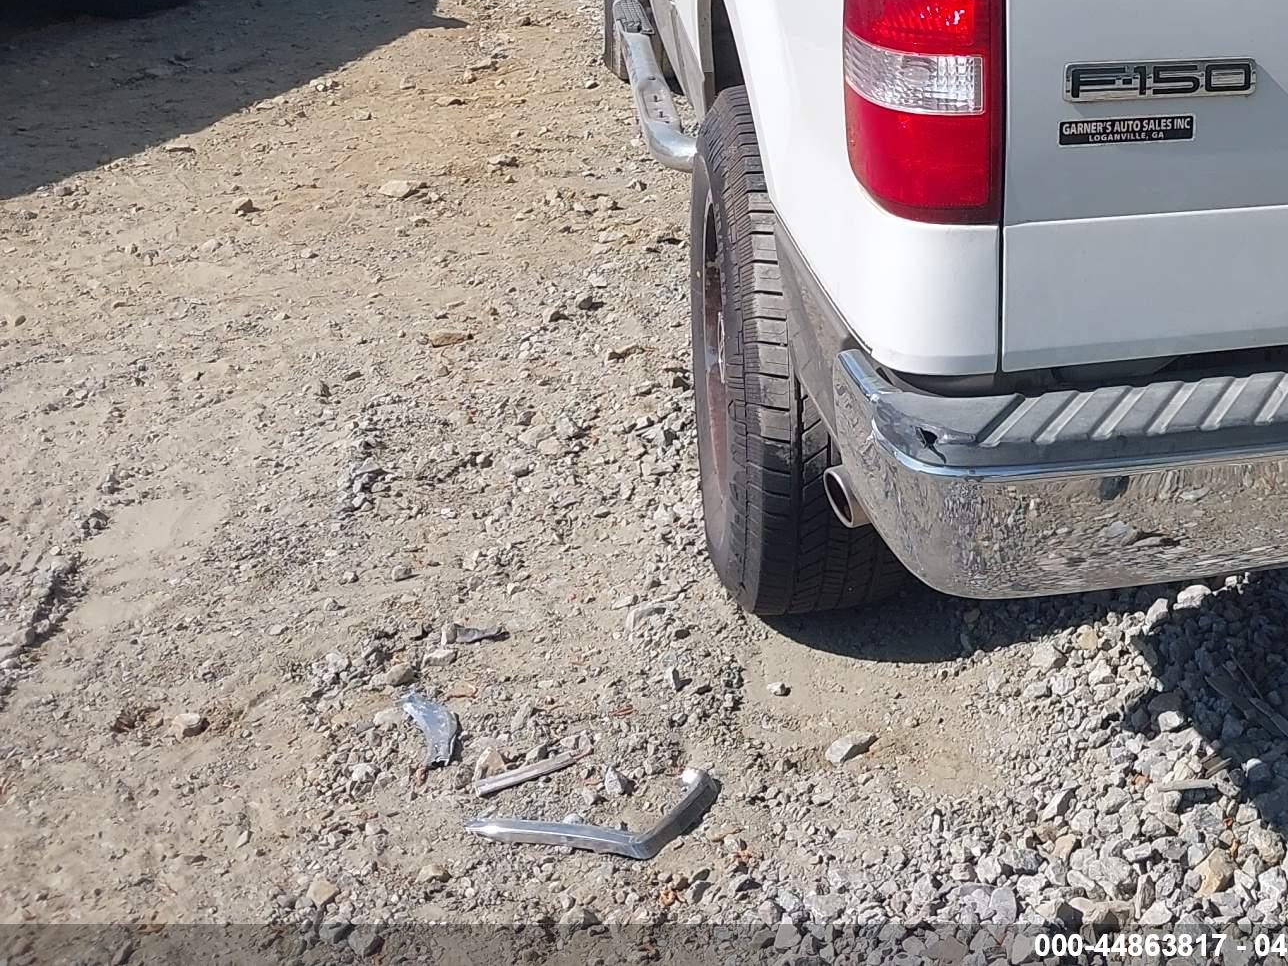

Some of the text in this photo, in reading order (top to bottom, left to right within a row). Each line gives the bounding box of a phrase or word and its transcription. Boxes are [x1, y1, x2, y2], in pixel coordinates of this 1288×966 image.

[1070, 62, 1253, 99] F-150
[1062, 117, 1191, 135] GARNER'S AUTO SALES INC
[1088, 132, 1165, 142] LOGANVILLE, GA
